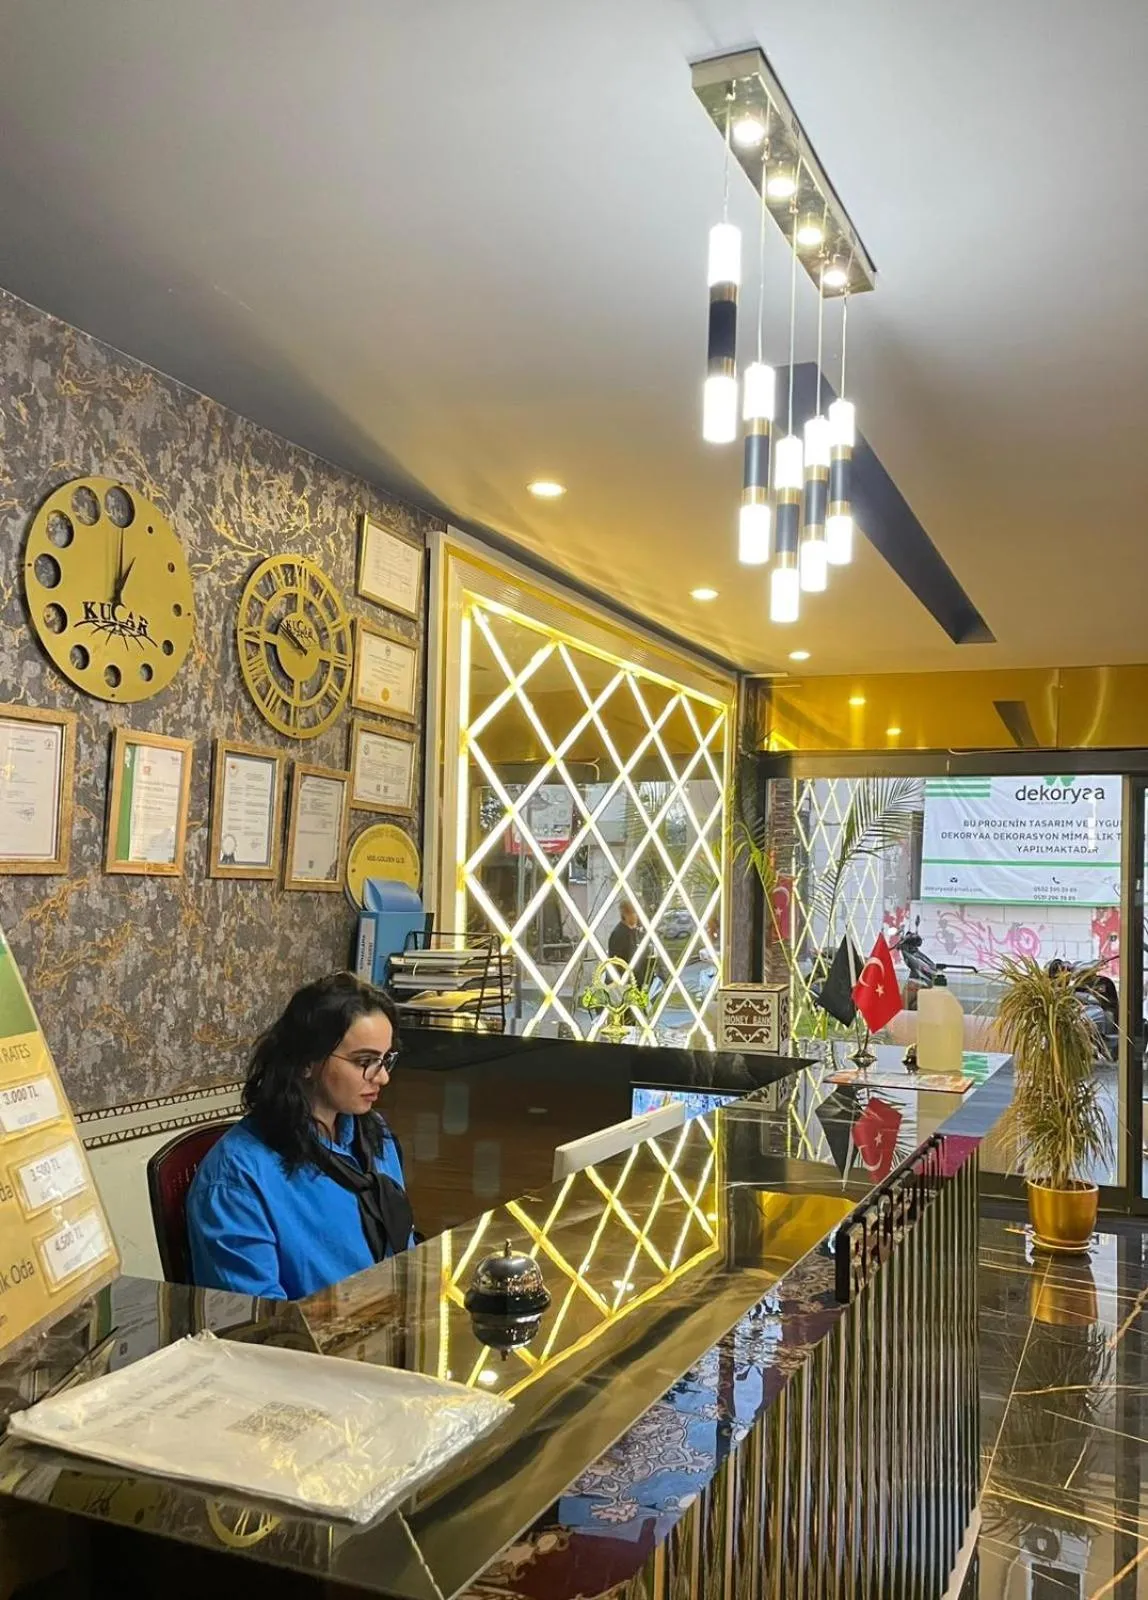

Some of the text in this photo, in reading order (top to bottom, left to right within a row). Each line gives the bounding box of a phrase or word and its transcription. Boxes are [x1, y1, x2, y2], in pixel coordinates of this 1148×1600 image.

[1015, 785, 1105, 804] dekoryaa
[963, 820, 976, 828] BU
[1029, 820, 1074, 828] TASARIM
[941, 832, 990, 840] DEKORYAA
[993, 832, 1059, 841] DEKORASYON
[1062, 831, 1115, 841] MİMALIK
[1, 1043, 31, 1063] RATES
[27, 1085, 40, 1101] TL
[10, 1258, 35, 1285] Oda
